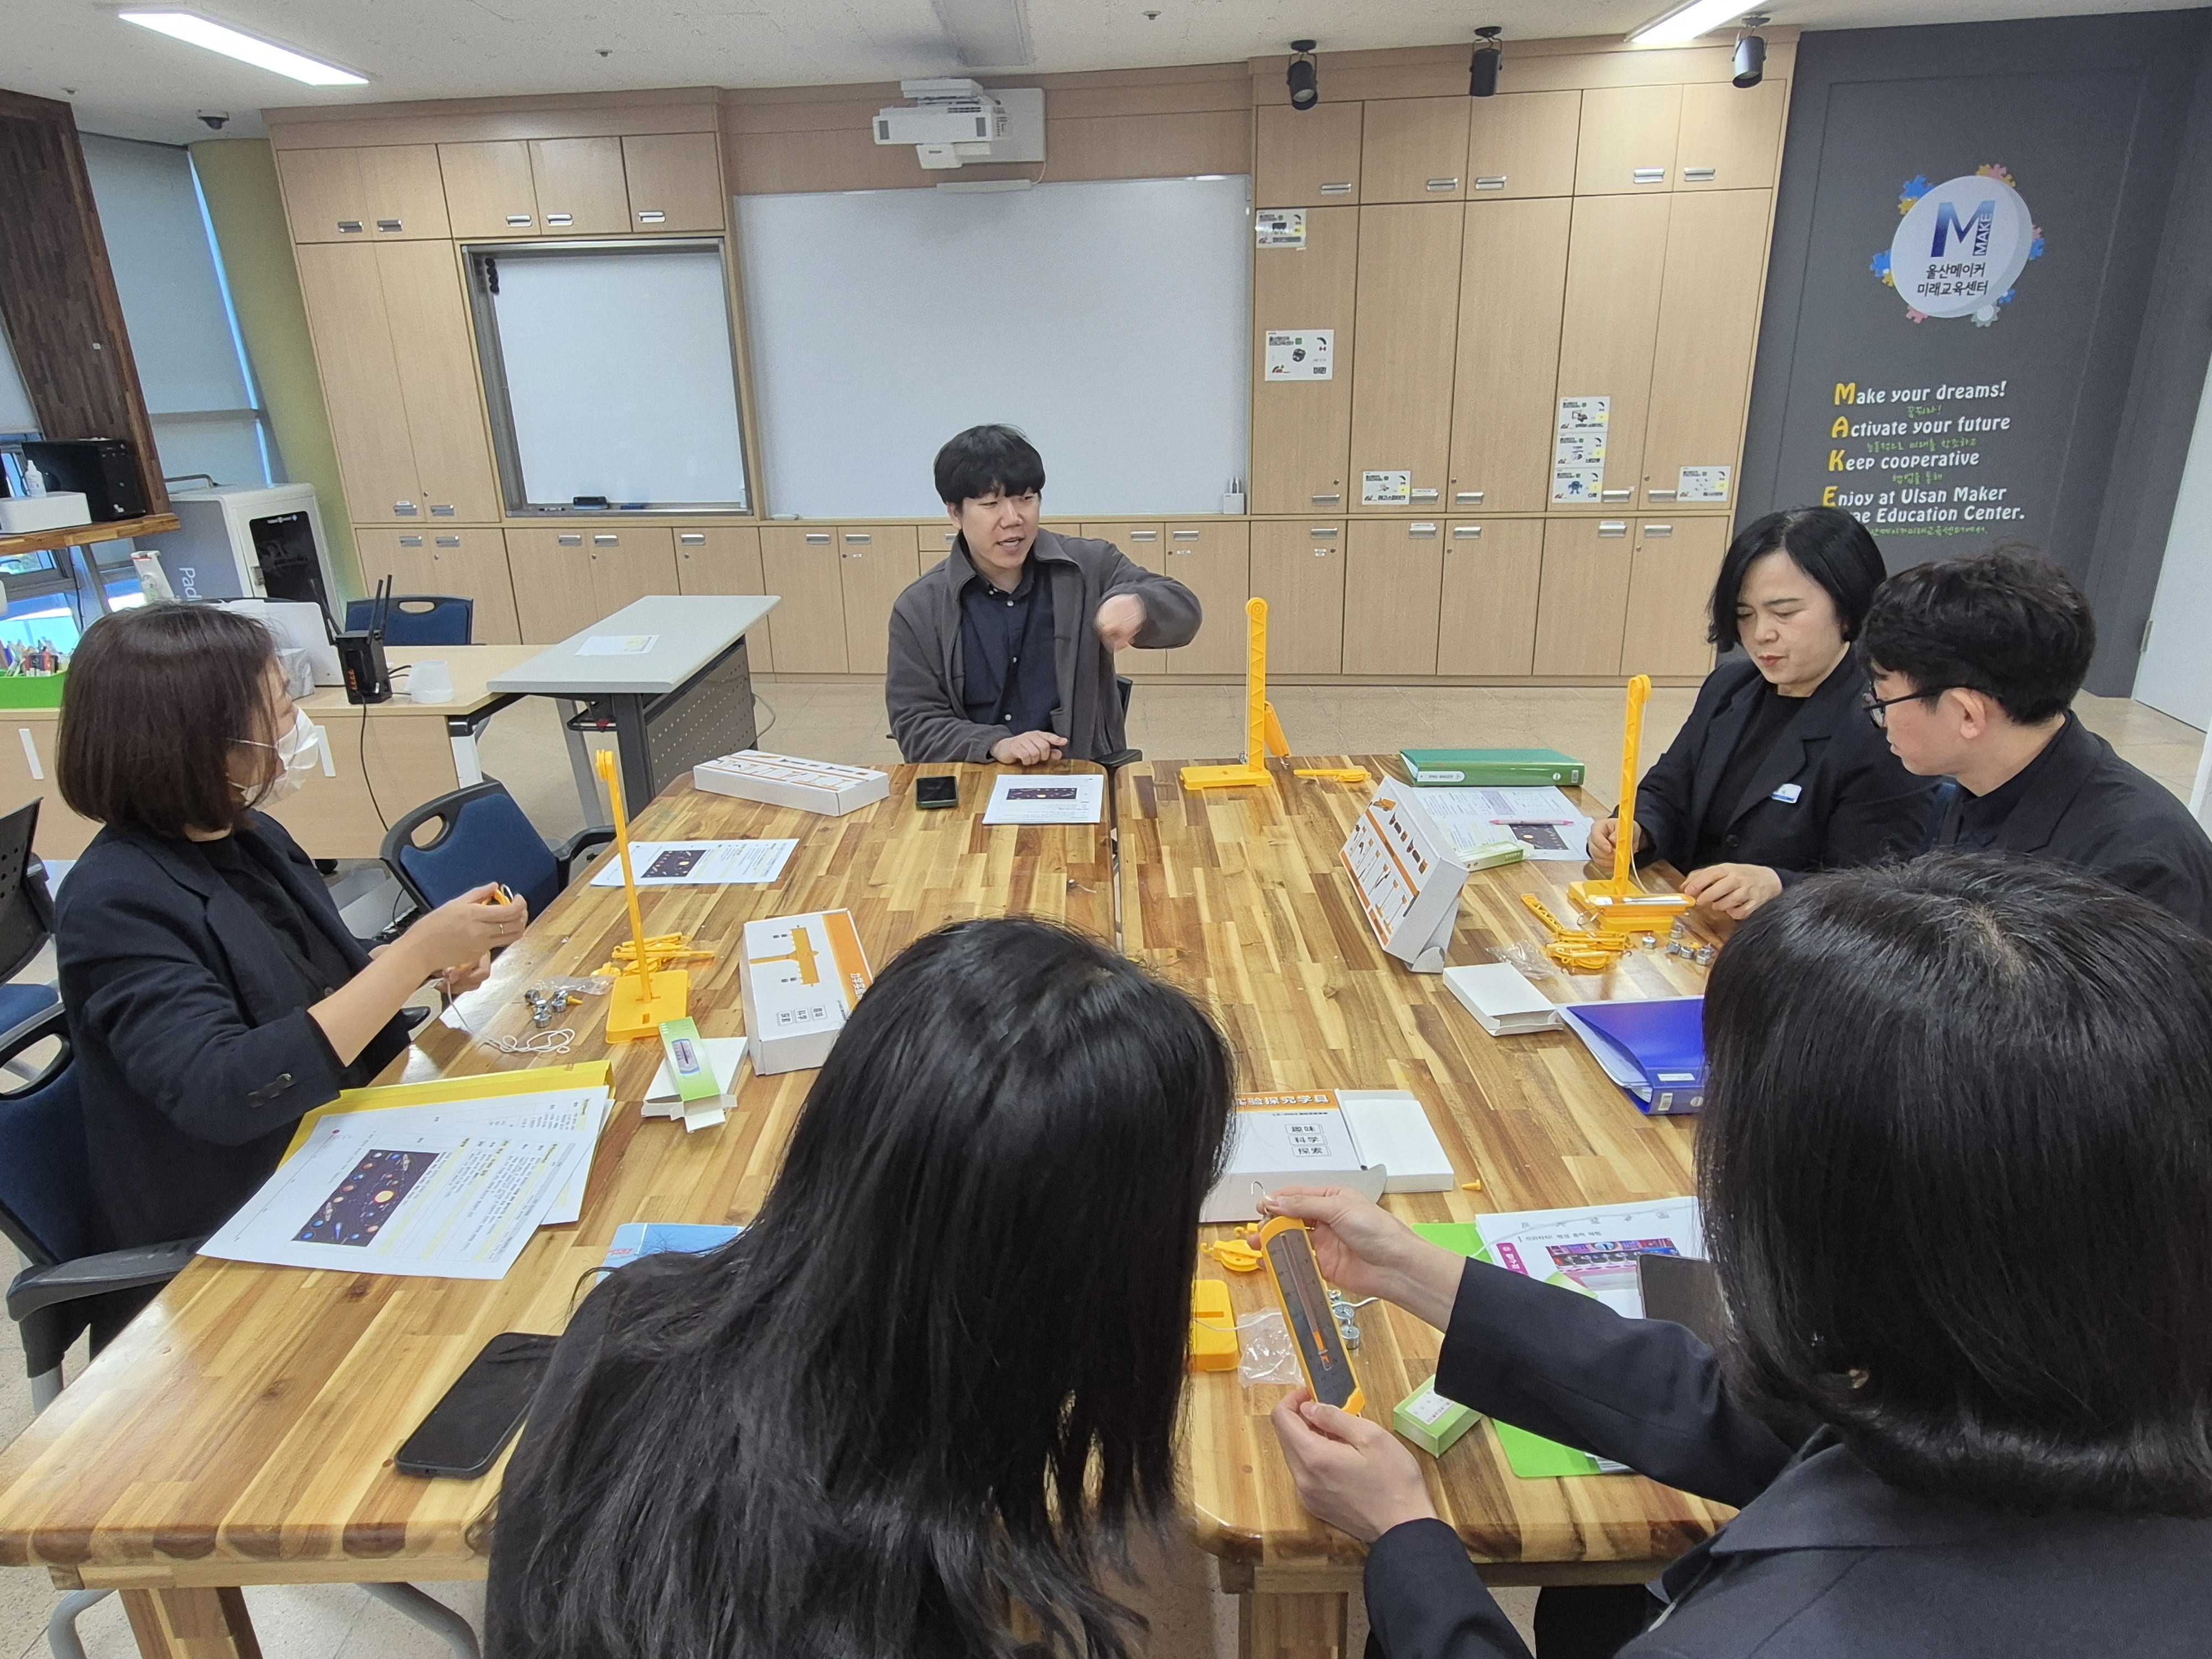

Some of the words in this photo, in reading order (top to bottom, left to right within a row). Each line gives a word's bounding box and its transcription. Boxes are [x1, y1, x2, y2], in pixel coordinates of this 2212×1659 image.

[1931, 200, 1995, 258] M
[1974, 213, 1992, 255] MAKE
[1926, 262, 1986, 279] 울산메이커
[1917, 280, 1989, 297] 미래교육센터
[1834, 382, 1886, 405] Make
[1890, 388, 1930, 403] your
[1936, 380, 2007, 400] dreams!
[1831, 416, 1907, 437] Activate
[1912, 420, 1952, 435] your
[1958, 416, 2011, 432] future
[1828, 449, 1875, 471] Keep
[1881, 450, 1980, 469] cooperative
[1823, 486, 1874, 508] Enjoy
[1879, 489, 1895, 505] at
[1901, 488, 1947, 504] Ulsan
[1953, 486, 2007, 503] Maker
[1876, 506, 1958, 524] Education
[1964, 505, 2026, 521] Center.
